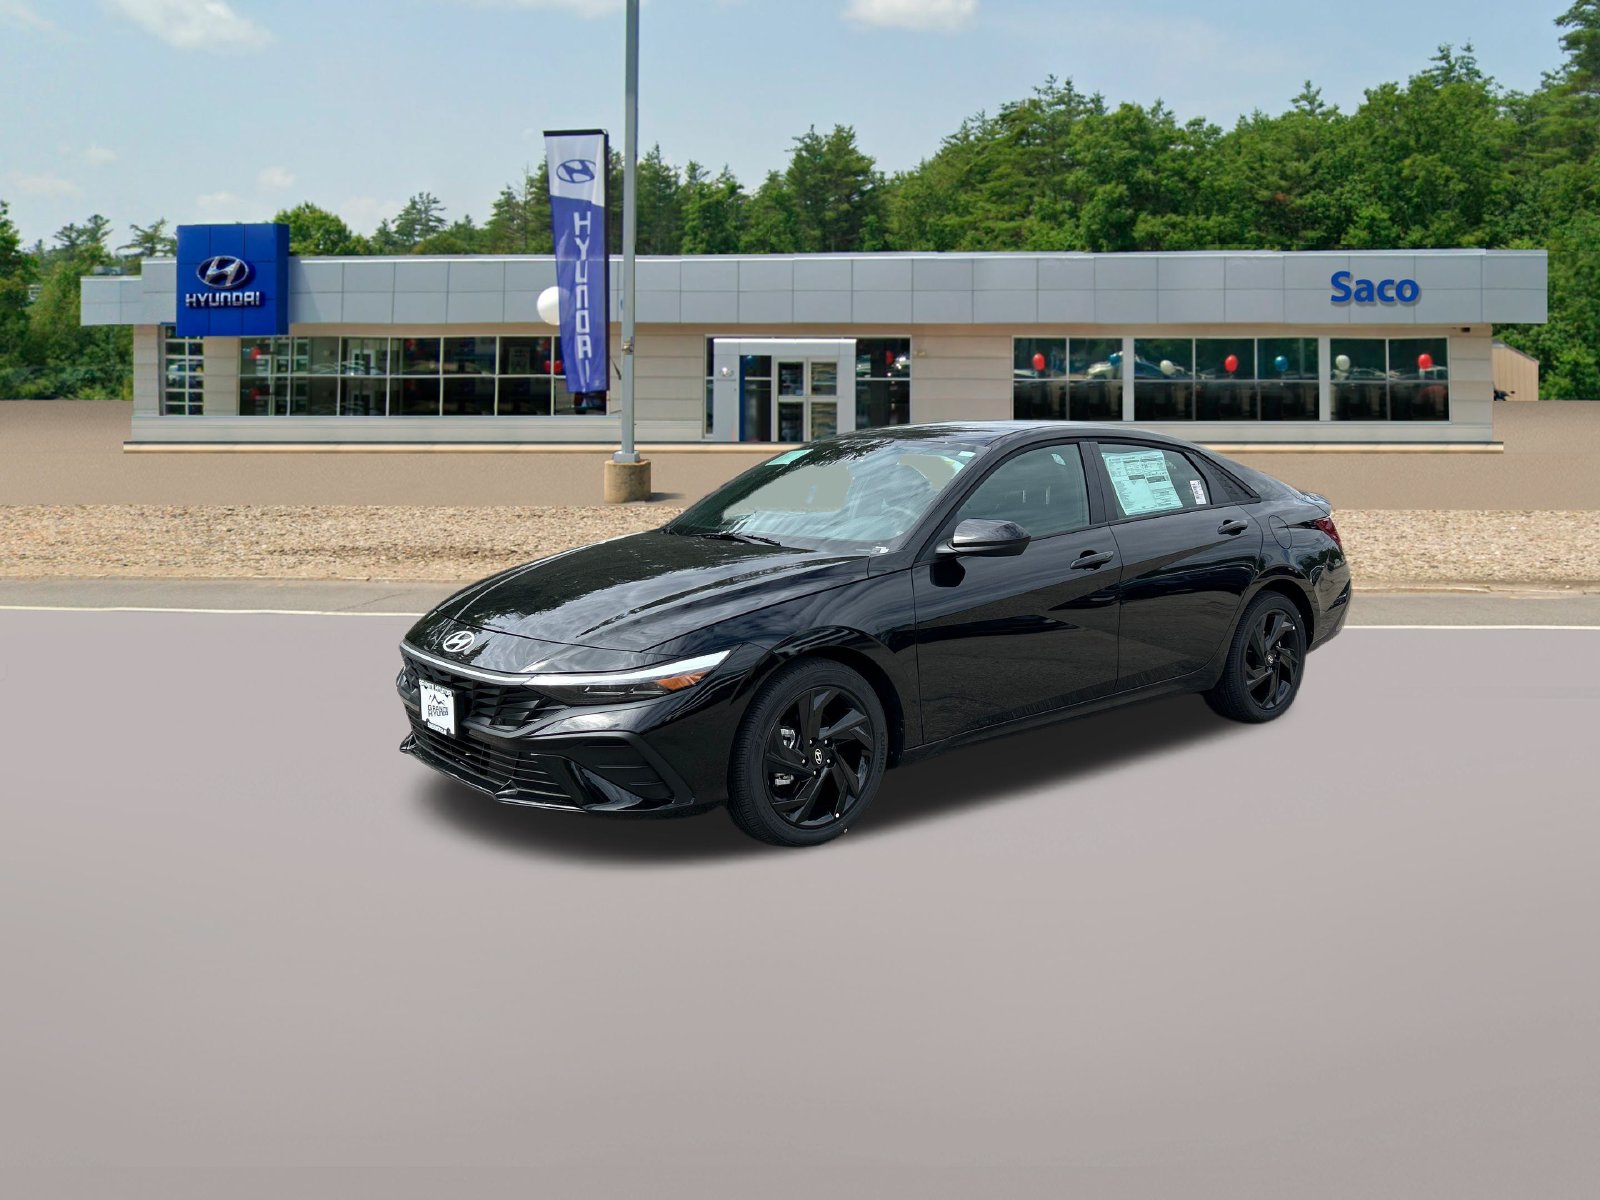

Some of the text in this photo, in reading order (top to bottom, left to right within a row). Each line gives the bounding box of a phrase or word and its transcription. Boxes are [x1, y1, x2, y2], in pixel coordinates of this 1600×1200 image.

[185, 291, 260, 307] HYUNDAI
[573, 211, 592, 383] HYUNDAI
[1330, 270, 1420, 303] Saco
